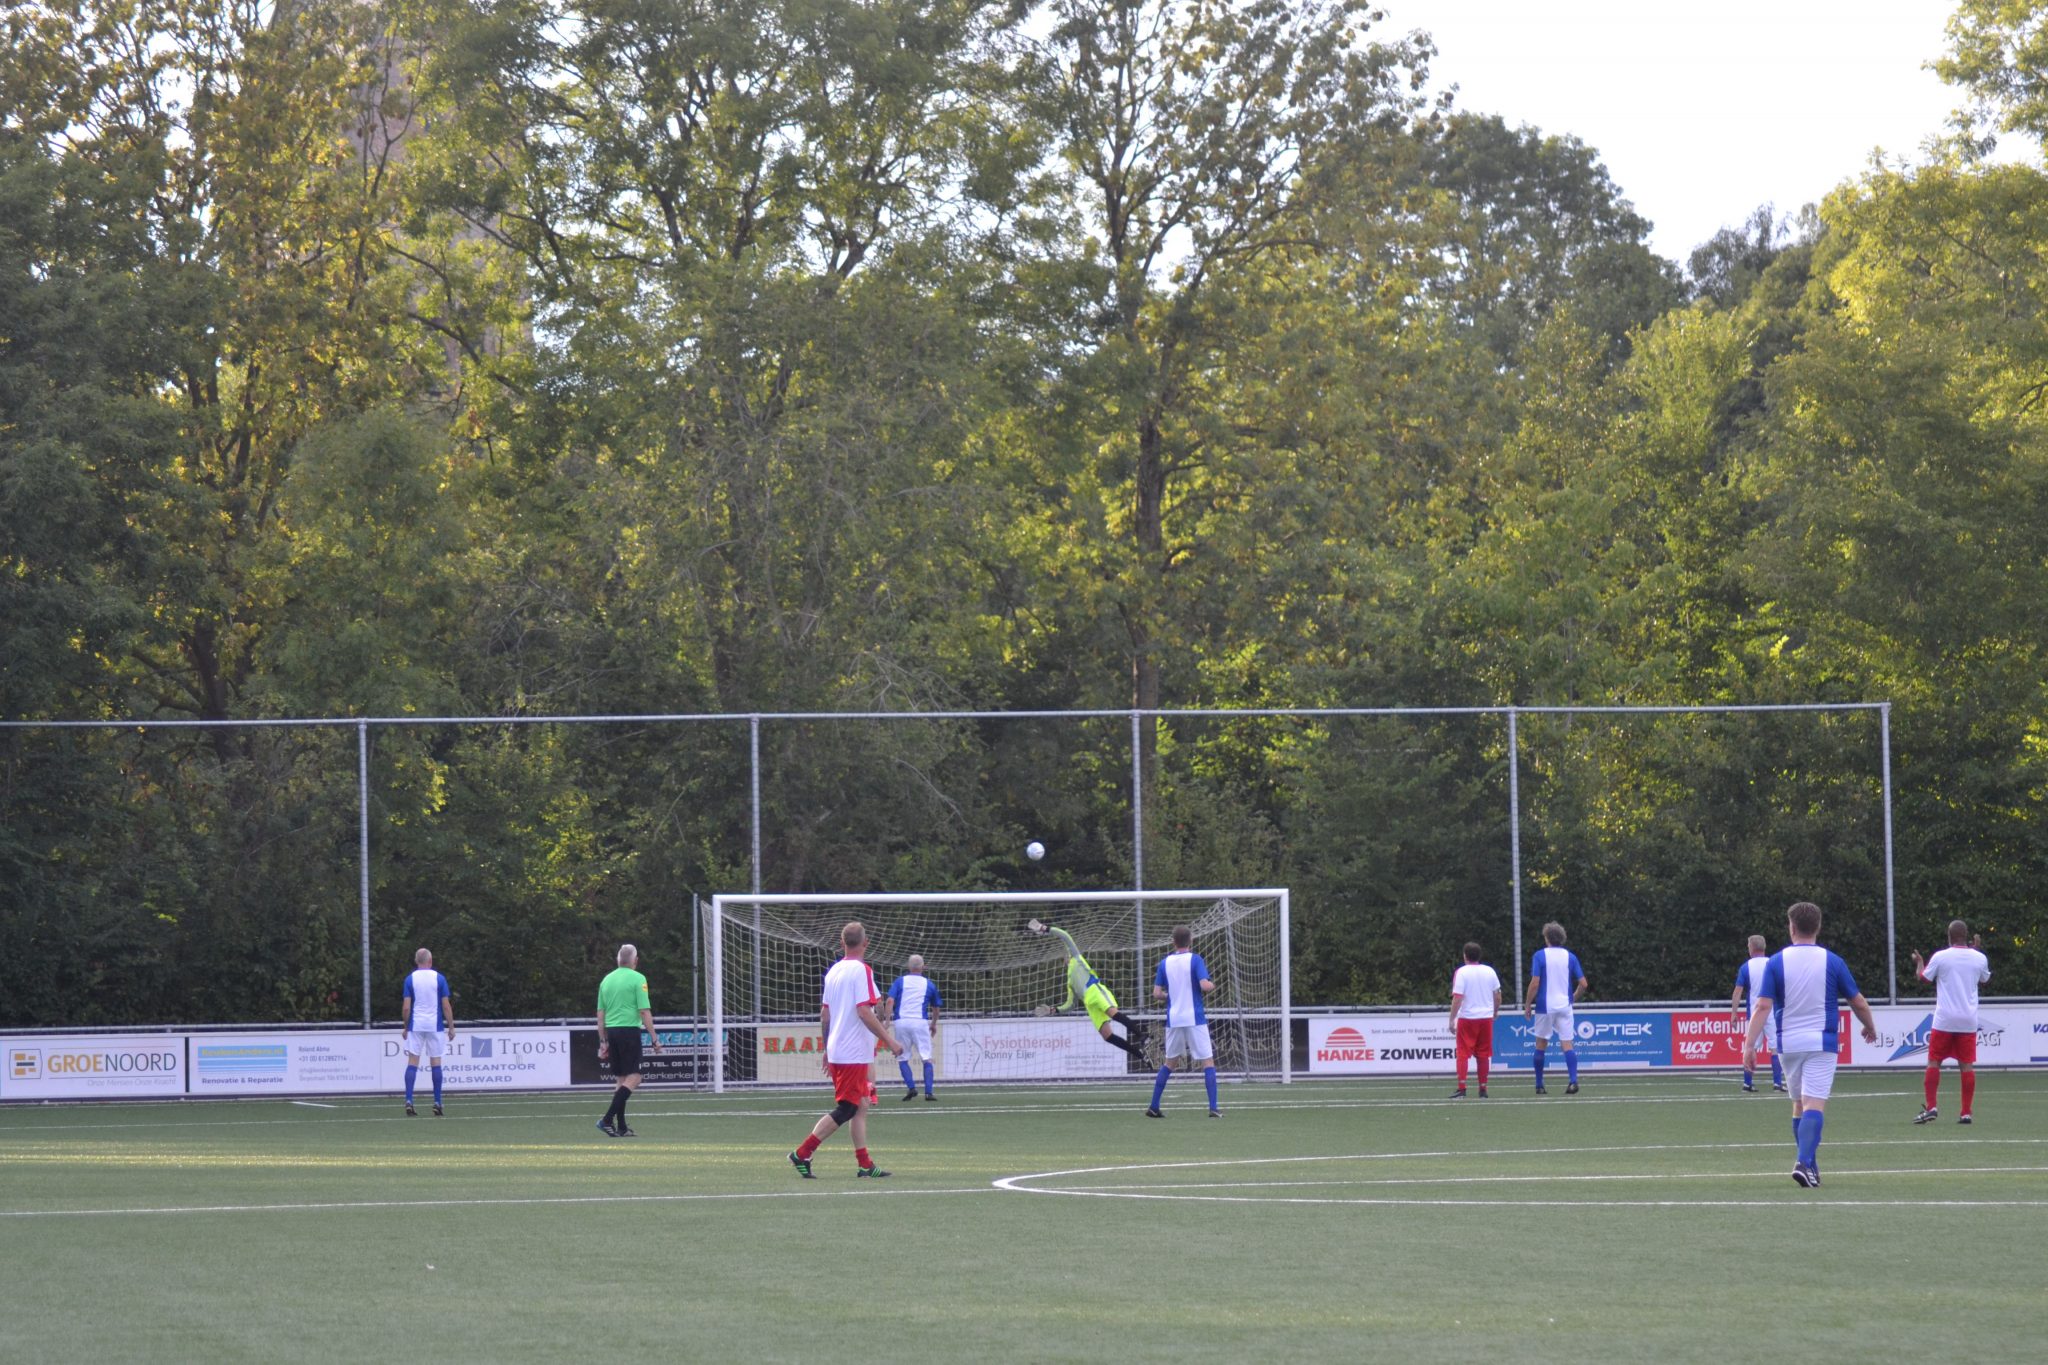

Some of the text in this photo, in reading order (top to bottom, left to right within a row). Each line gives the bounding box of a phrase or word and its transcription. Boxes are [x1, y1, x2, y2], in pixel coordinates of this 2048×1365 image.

[497, 1037, 568, 1055] Troost
[984, 1036, 1072, 1052] Fysiotherapie
[1874, 1030, 1894, 1048] de
[984, 1049, 1036, 1060] Ronny Eijer
[1317, 1049, 1375, 1061] HANZE
[47, 1053, 177, 1073] GROENOORD
[416, 1063, 536, 1073] NOARISKANTOOR
[202, 1077, 239, 1085] Renovatie
[247, 1076, 284, 1084] Reparatie
